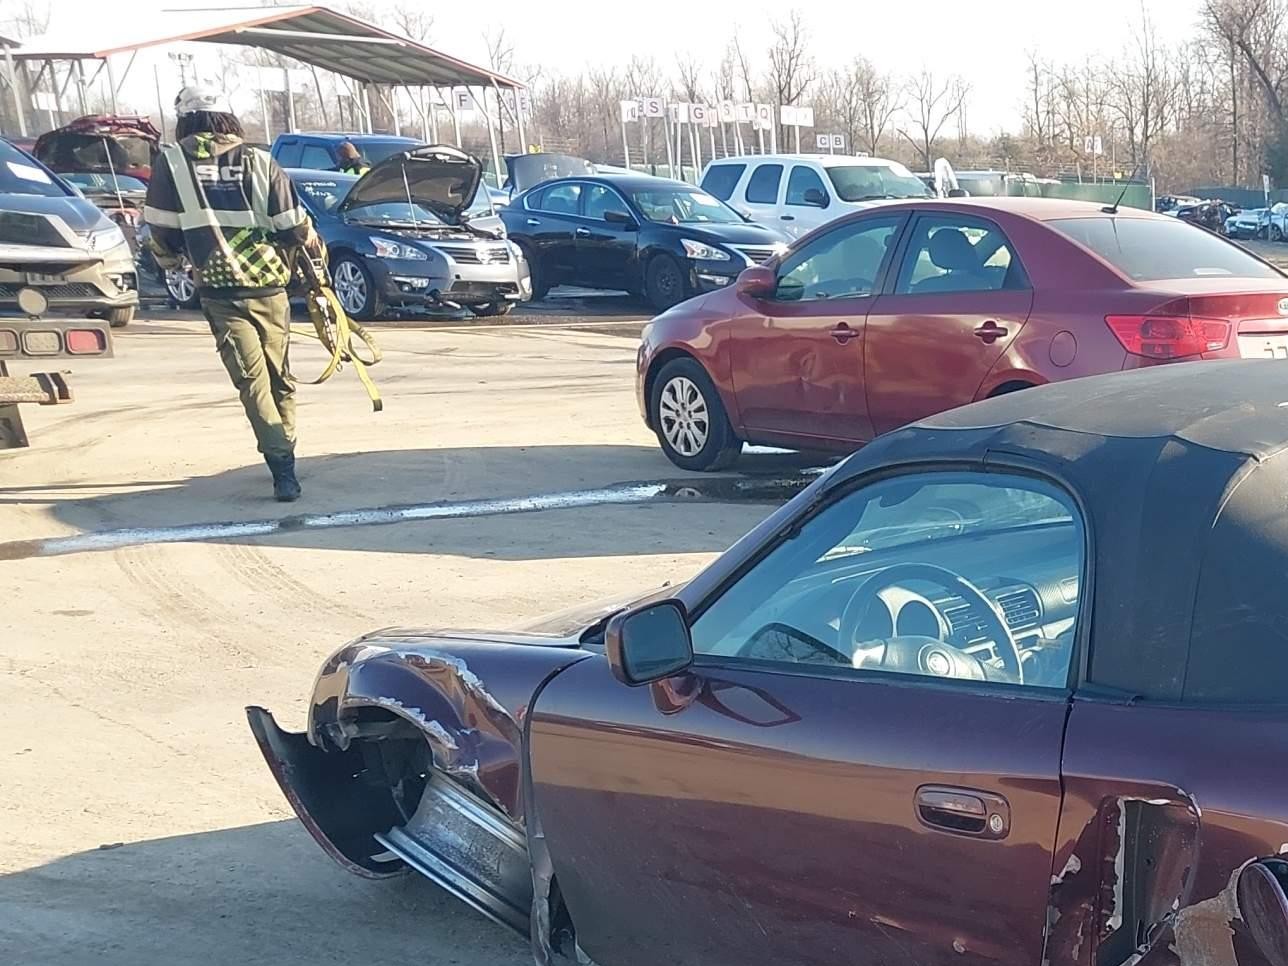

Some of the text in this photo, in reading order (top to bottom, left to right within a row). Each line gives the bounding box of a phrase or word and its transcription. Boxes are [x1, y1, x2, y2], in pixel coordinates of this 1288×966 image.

[459, 94, 468, 107] F
[649, 101, 660, 114] S
[693, 107, 704, 119] G
[819, 136, 828, 146] C
[834, 136, 842, 146] B
